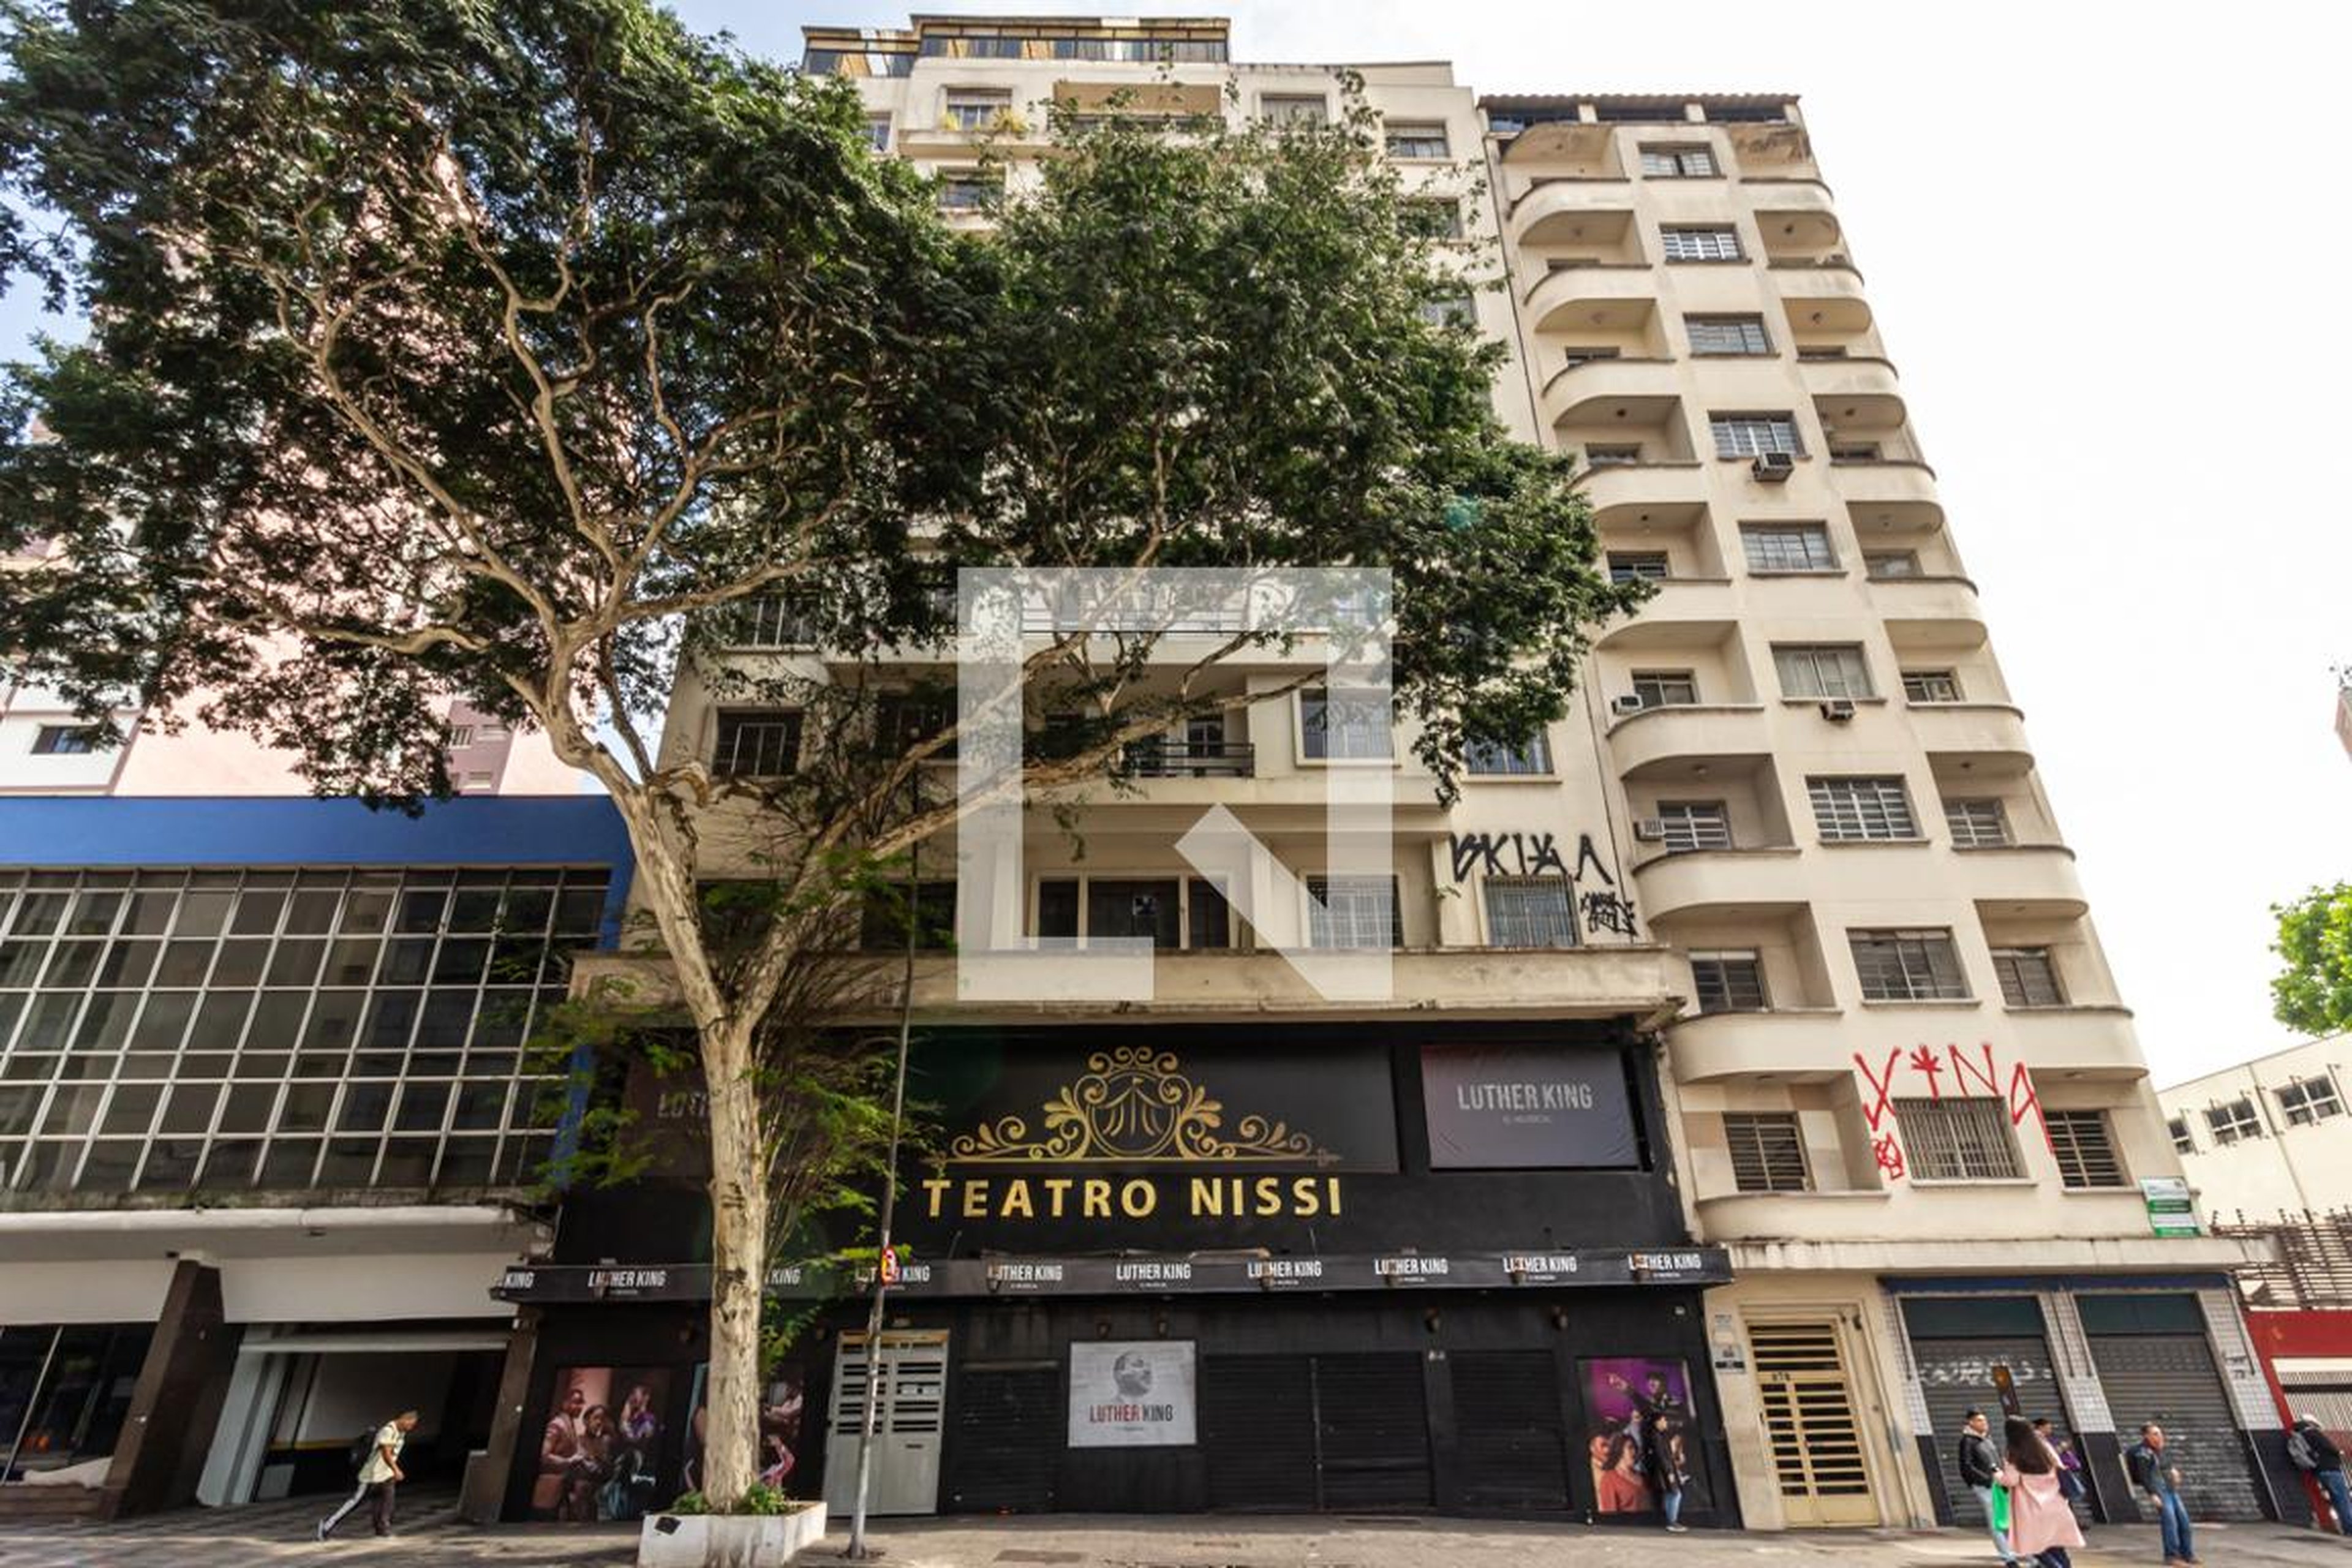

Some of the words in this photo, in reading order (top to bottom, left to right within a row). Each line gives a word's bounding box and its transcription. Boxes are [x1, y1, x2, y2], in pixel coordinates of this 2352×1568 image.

[1457, 1083, 1539, 1110] LUTHER
[1542, 1083, 1593, 1109] KING
[922, 1178, 1157, 1218] TEATRO
[1191, 1177, 1341, 1216] NISSI
[1294, 1260, 1322, 1277] KING
[1420, 1257, 1449, 1275] KING
[1548, 1256, 1577, 1273] KING
[1673, 1253, 1702, 1270] KING
[636, 1270, 667, 1287] KING
[771, 1268, 801, 1285] KING
[902, 1265, 930, 1283] KING
[1035, 1265, 1063, 1281] KING
[1116, 1264, 1161, 1280] LUTHER
[1163, 1263, 1191, 1280] KING
[1090, 1404, 1140, 1423] LUTHER
[1142, 1403, 1174, 1422] KING
